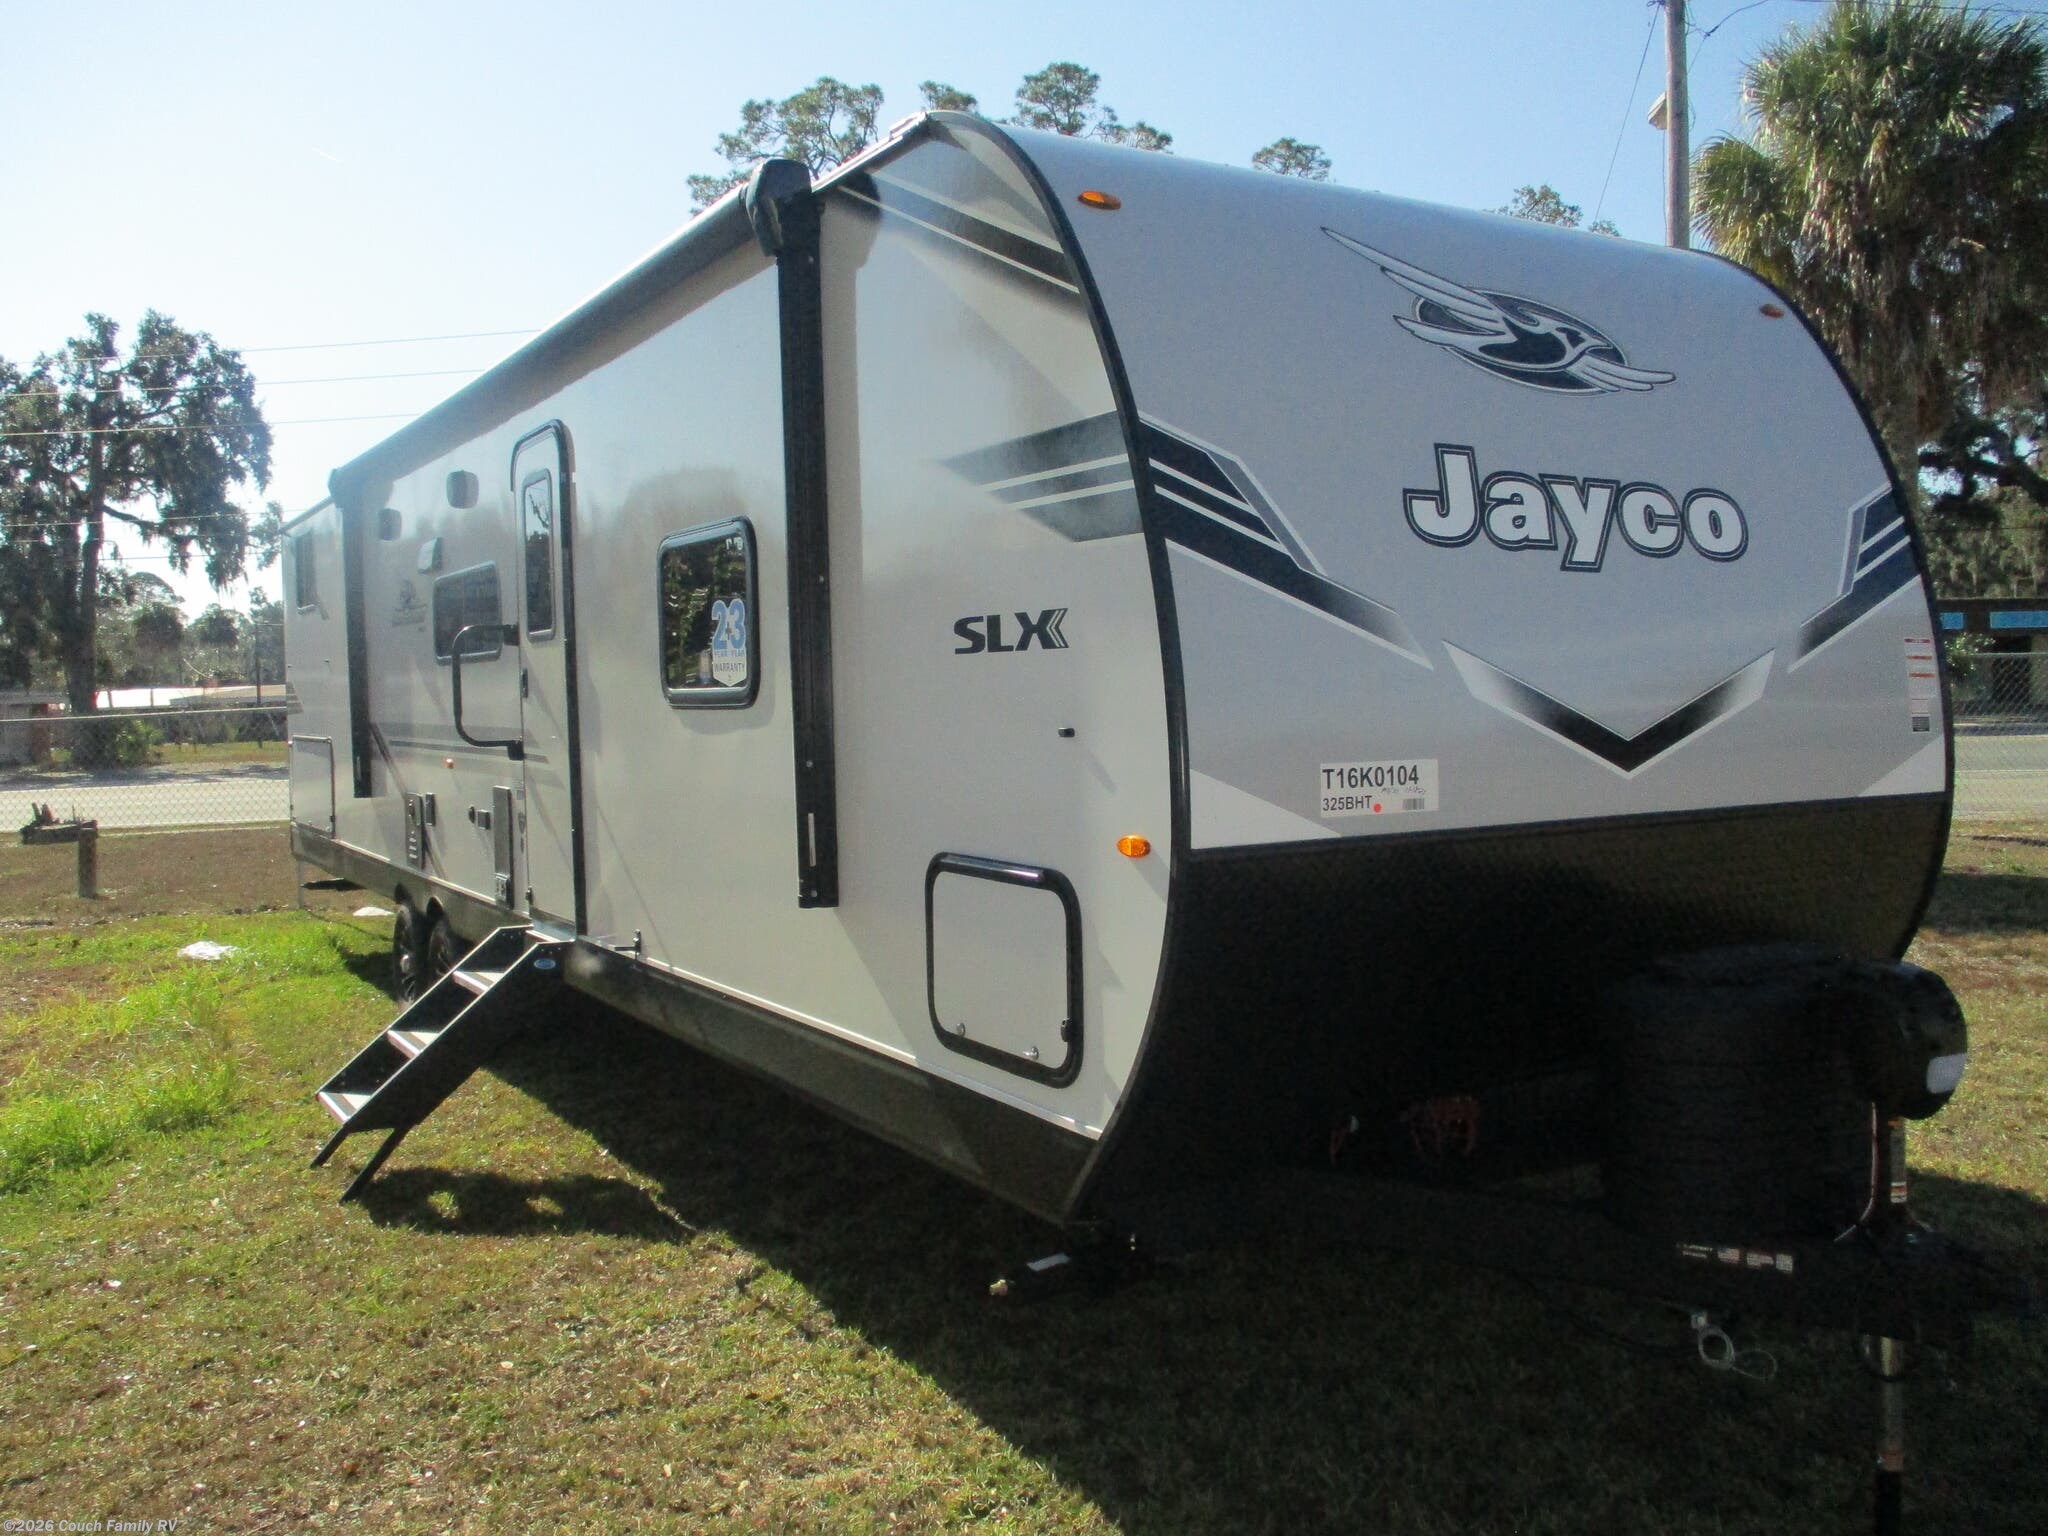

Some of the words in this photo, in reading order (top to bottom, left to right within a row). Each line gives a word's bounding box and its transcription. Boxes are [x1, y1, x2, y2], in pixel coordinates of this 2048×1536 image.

[1402, 442, 1749, 573] Jayco
[954, 608, 1069, 654] SLX
[713, 662, 745, 673] WARRANTY
[1322, 765, 1419, 789] T16K0104
[1322, 795, 1372, 811] 325BHT
